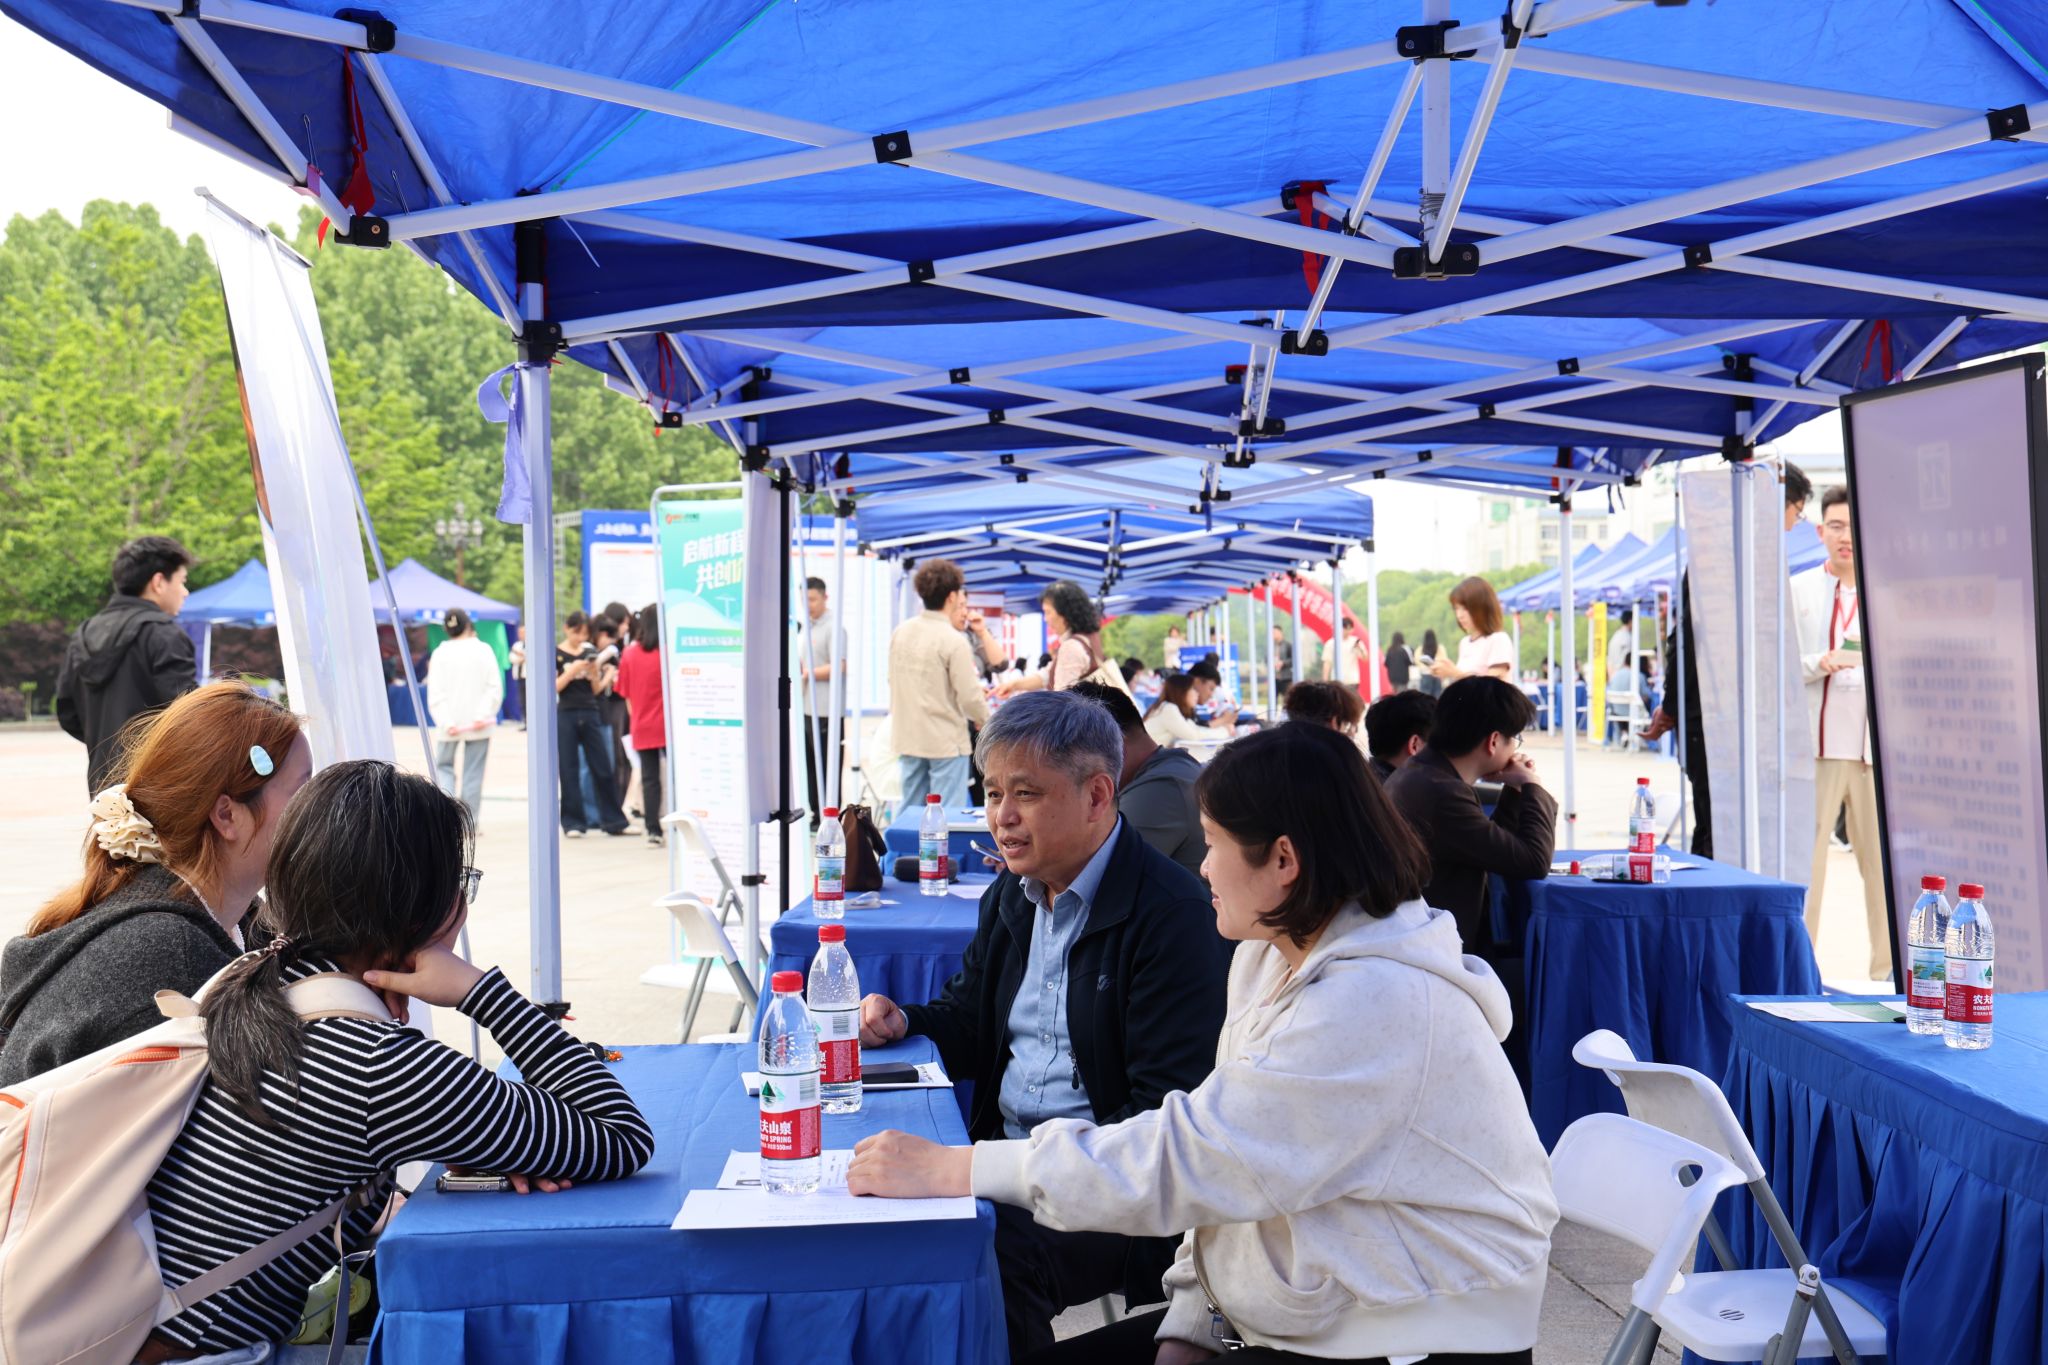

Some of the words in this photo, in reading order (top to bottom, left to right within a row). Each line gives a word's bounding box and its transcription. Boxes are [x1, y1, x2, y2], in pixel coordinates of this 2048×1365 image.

[760, 1119, 792, 1135] 夫山泉
[769, 1135, 792, 1143] SPRING
